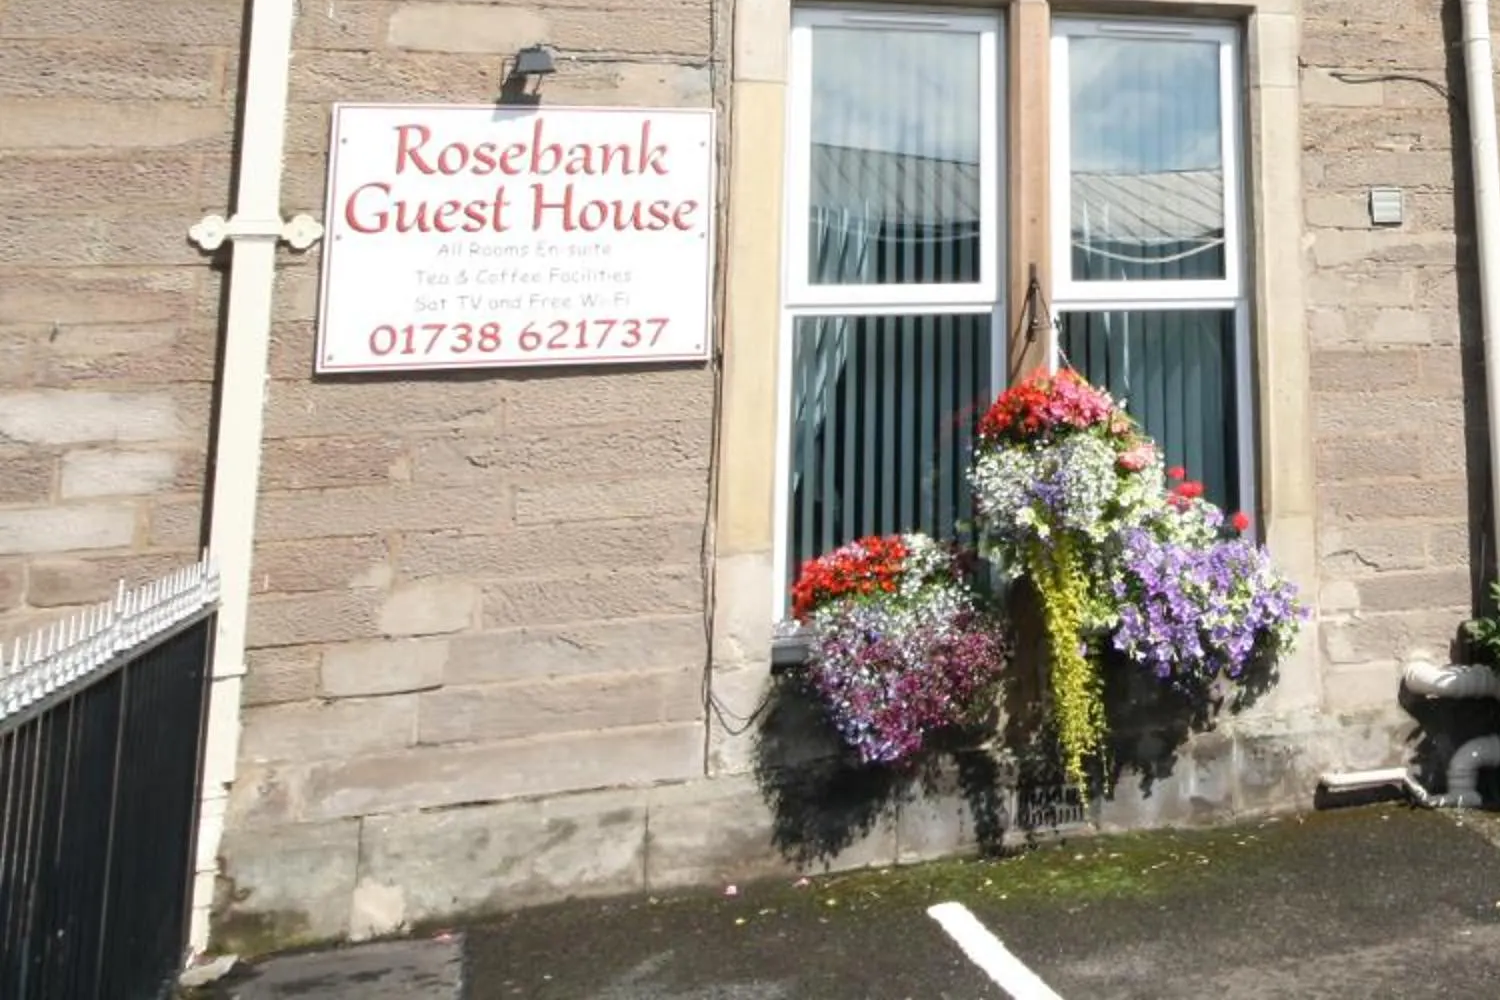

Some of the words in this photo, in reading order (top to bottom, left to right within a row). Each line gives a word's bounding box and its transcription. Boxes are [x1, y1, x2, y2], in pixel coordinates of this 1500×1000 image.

[393, 118, 670, 176] Rosebank
[344, 182, 510, 234] Guest
[530, 183, 698, 232] House
[435, 242, 463, 258] All
[469, 241, 529, 258] Rooms
[415, 269, 449, 285] Tea
[454, 268, 469, 285] &
[475, 267, 541, 285] Coffee
[549, 266, 632, 284] Facilities
[414, 294, 447, 312] Sat
[455, 293, 483, 311] TV
[488, 293, 522, 311] and
[529, 293, 572, 309] Free
[579, 291, 631, 308] WFi
[368, 321, 501, 356] 01738
[518, 318, 671, 352] 621737
